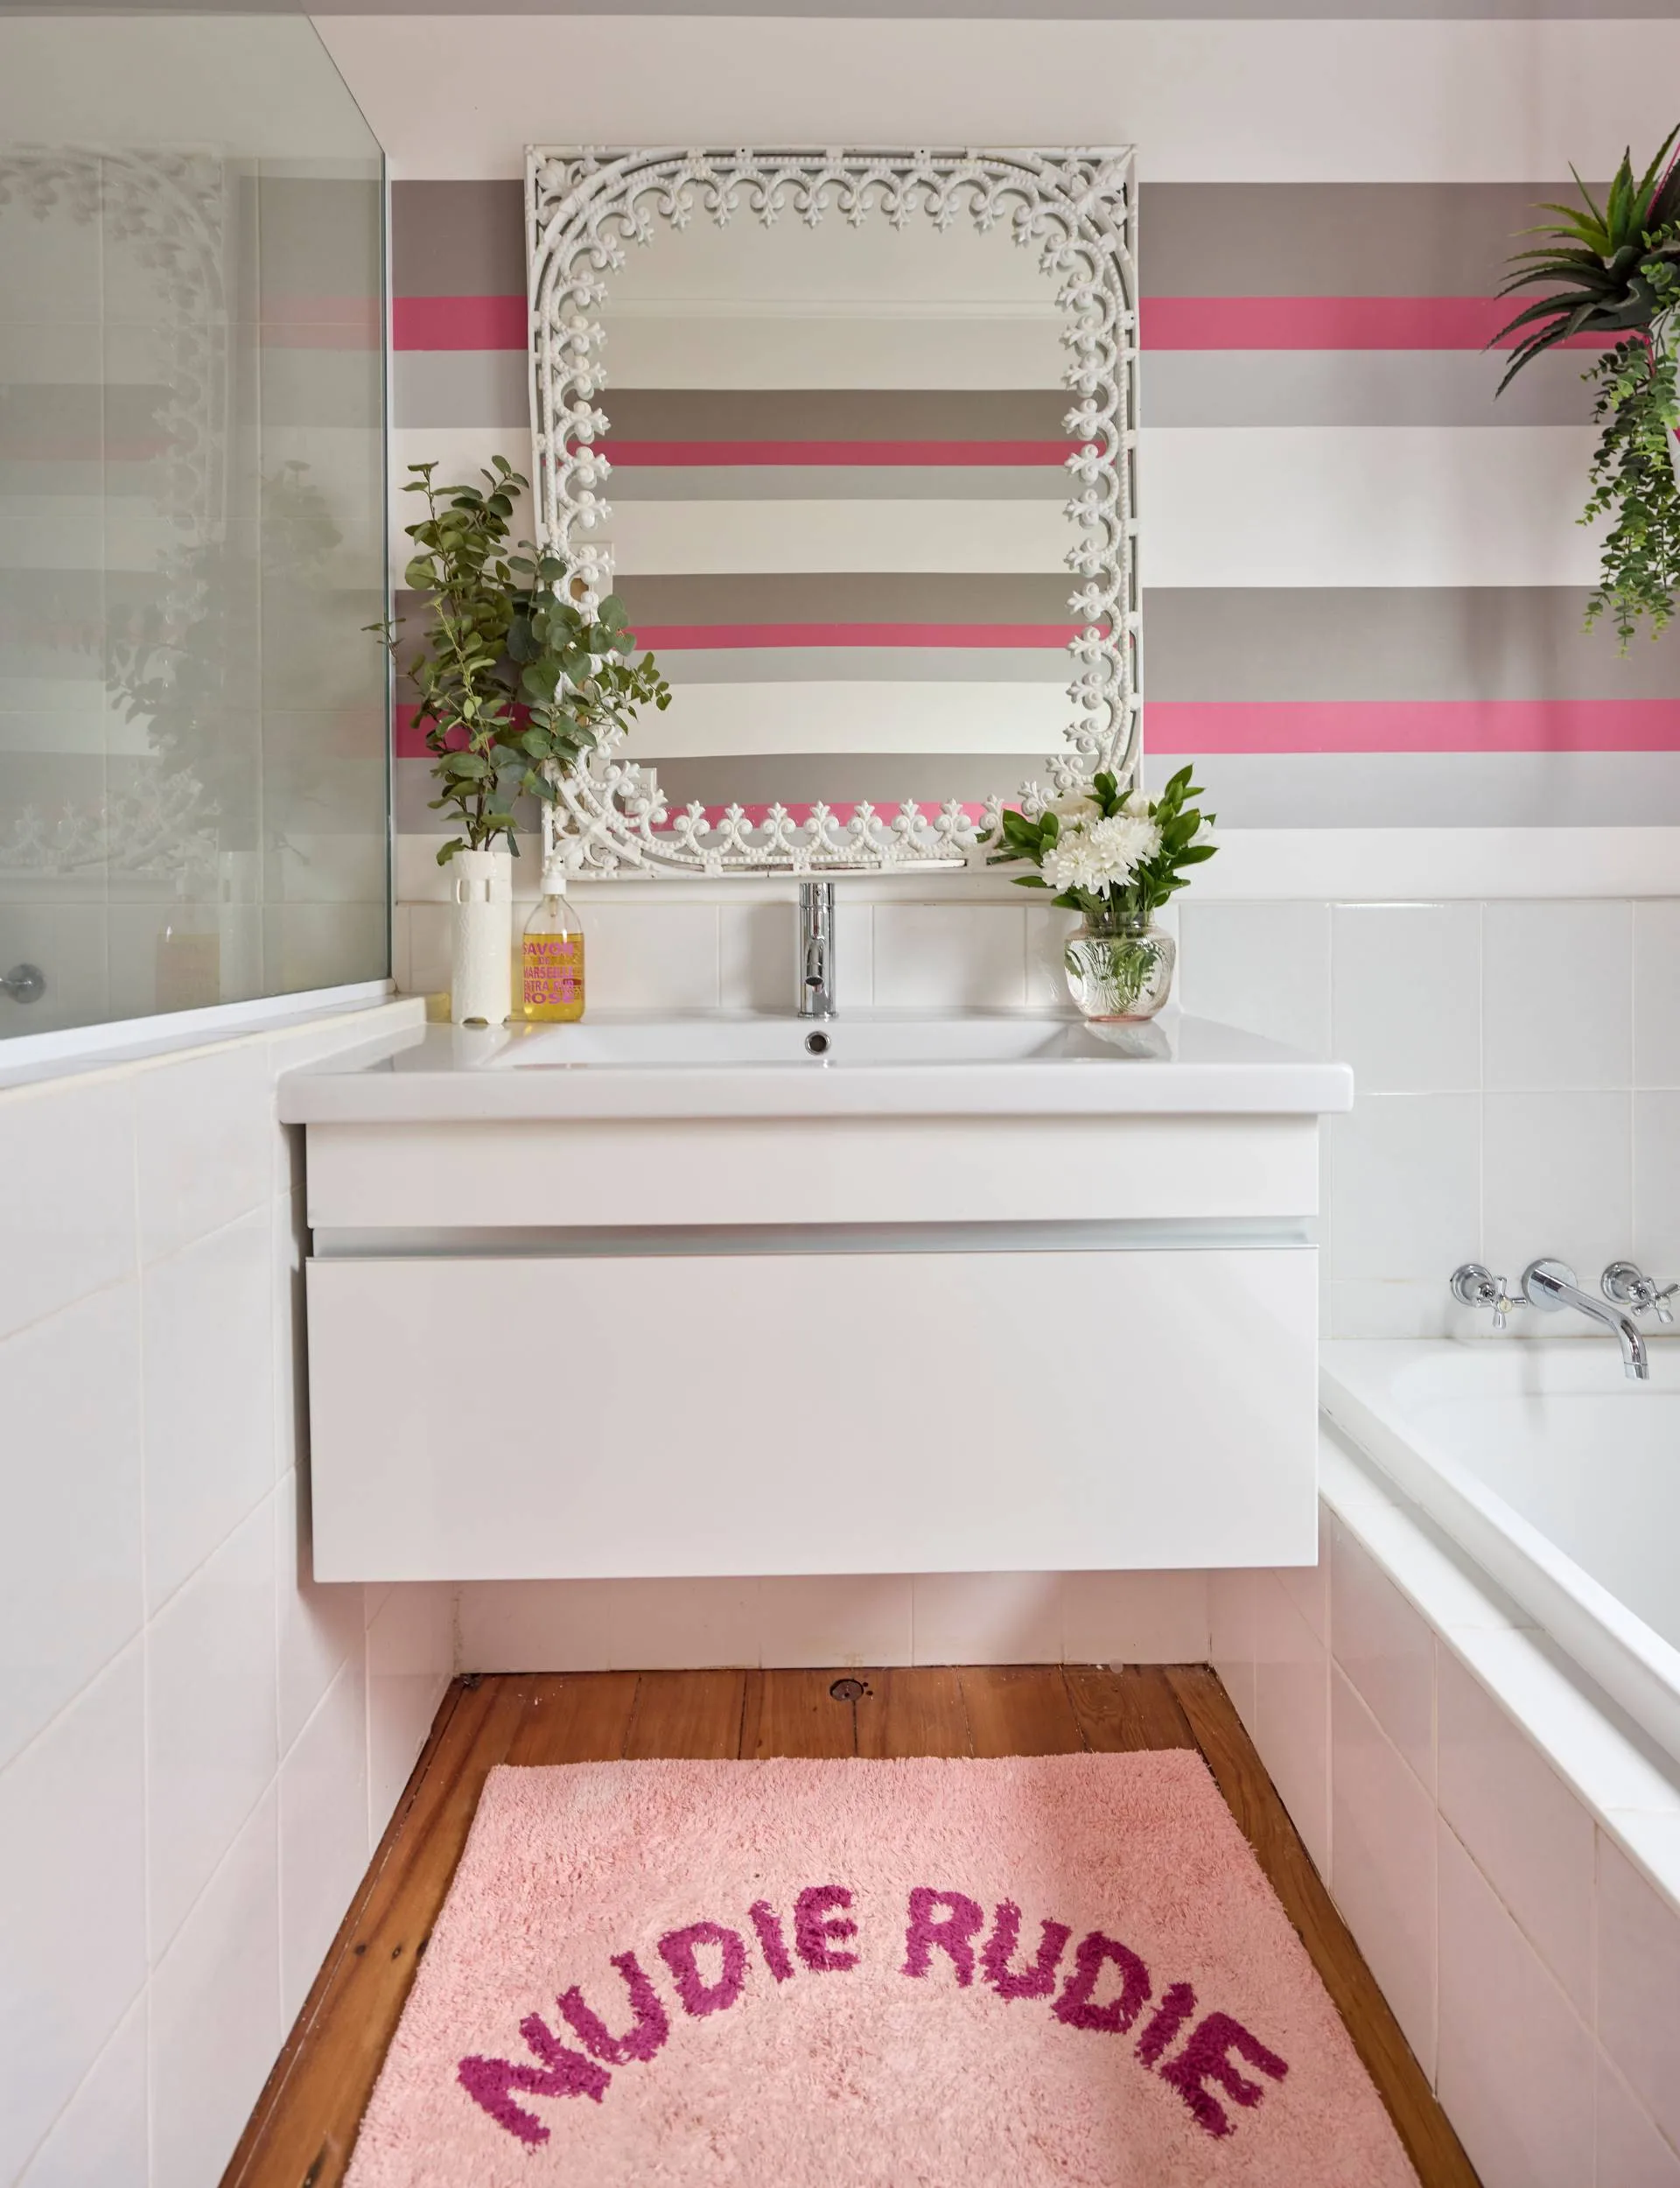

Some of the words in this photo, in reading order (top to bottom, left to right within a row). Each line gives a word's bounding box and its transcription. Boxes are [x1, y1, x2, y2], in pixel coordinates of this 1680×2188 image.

[522, 942, 574, 956] SAVON
[523, 965, 574, 979] MARSEILLE
[523, 992, 575, 1005] ROSE
[458, 1884, 858, 2145] NUDIE
[901, 1886, 1287, 2136] RUDIE
